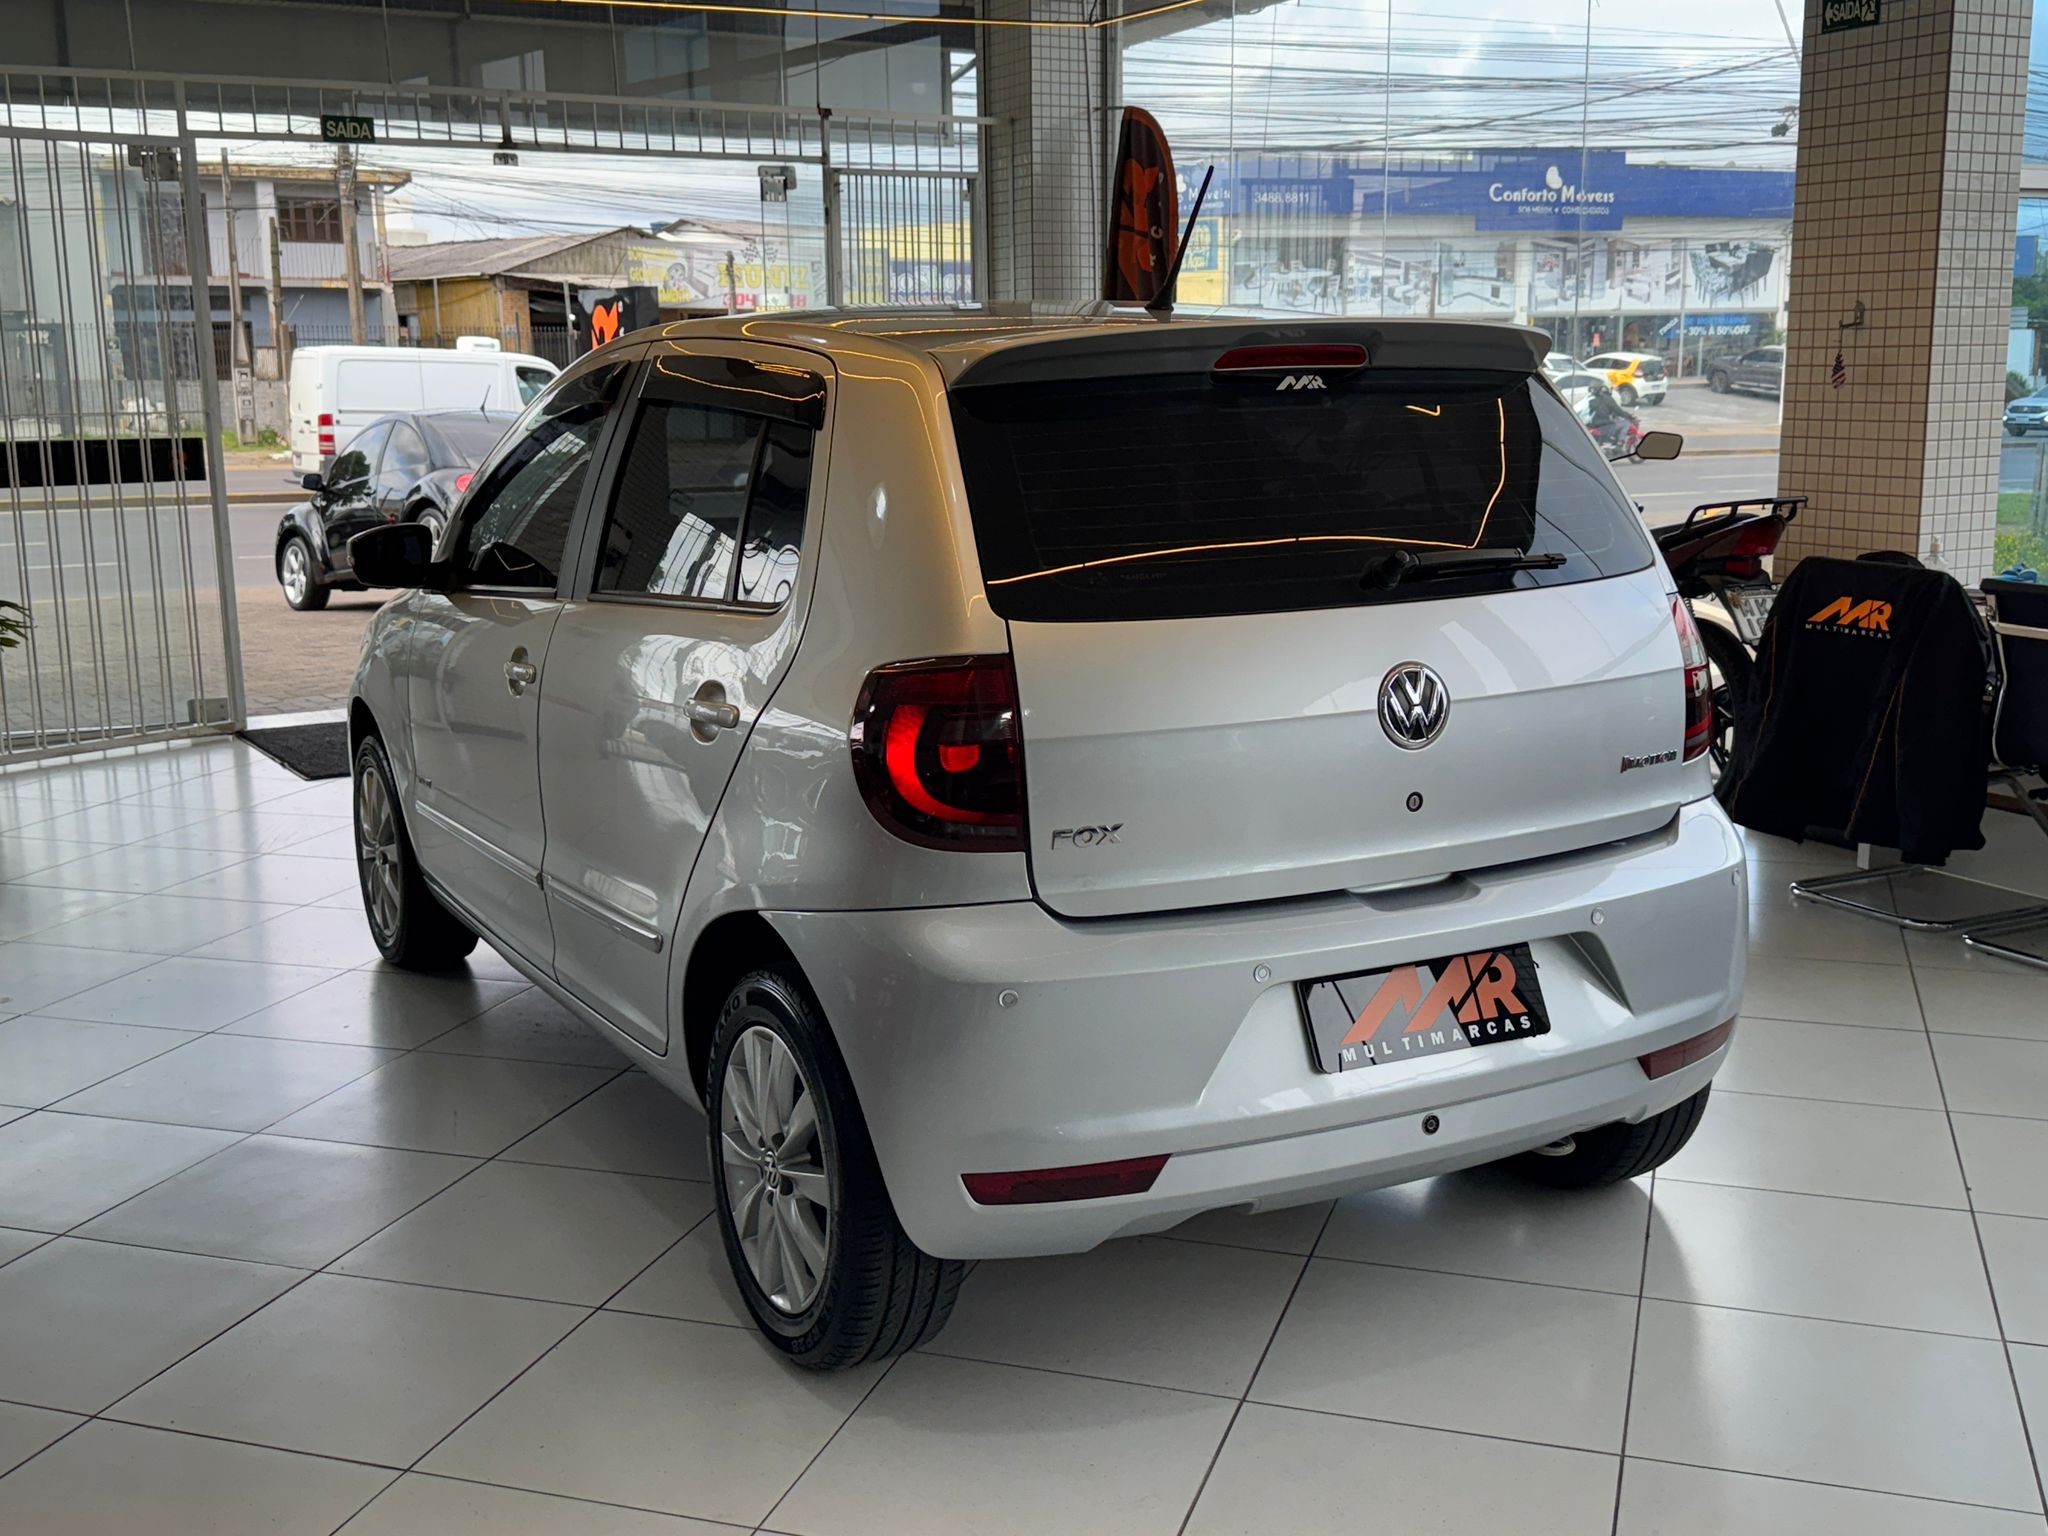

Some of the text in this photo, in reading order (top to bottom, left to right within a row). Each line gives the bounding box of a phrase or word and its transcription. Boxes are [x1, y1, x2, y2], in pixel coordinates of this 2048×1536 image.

[326, 118, 372, 140] SAÍDA
[1254, 191, 1310, 203] 3488.8811
[1489, 182, 1557, 202] Conforto
[1050, 822, 1125, 851] FOX
[1341, 1014, 1532, 1063] MULTIMARCAS
